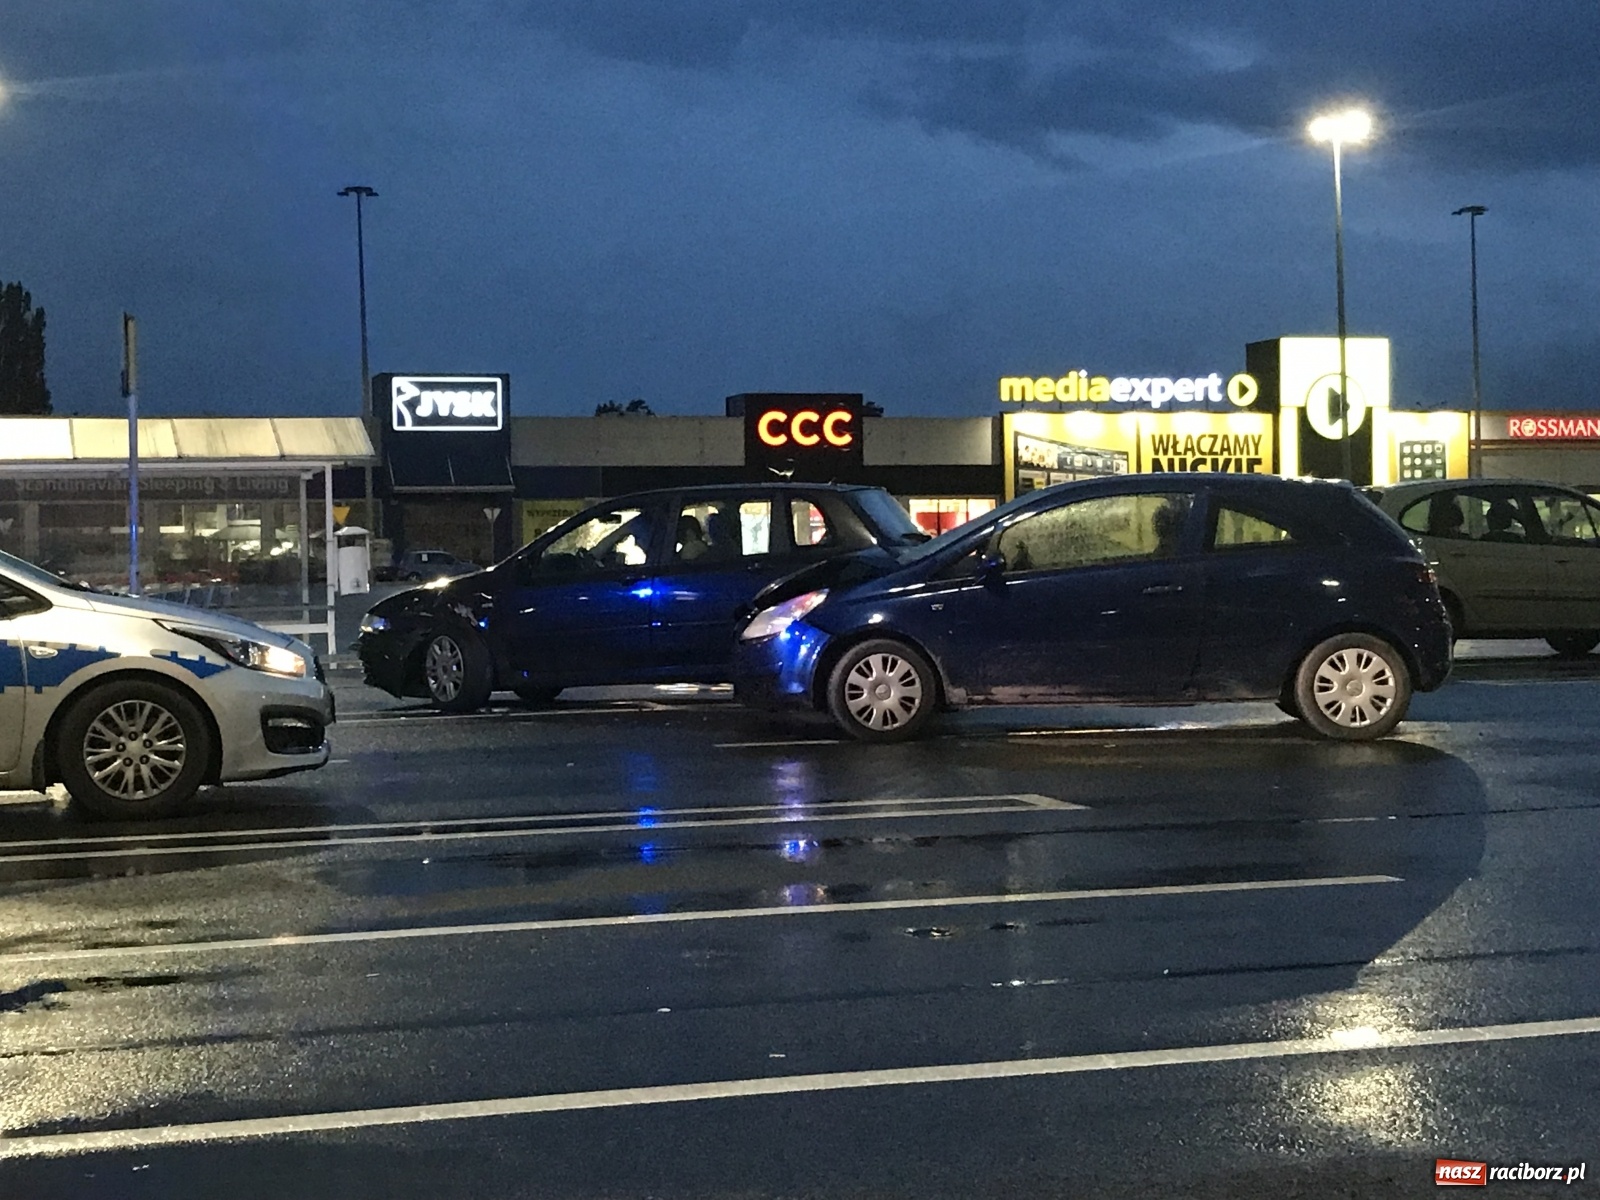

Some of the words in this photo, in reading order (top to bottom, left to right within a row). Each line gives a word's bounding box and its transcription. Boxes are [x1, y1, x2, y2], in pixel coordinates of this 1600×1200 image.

[1000, 369, 1222, 408] mediaexpert
[416, 391, 496, 417] JYSK
[757, 410, 852, 446] CCC
[1151, 434, 1262, 458] WŁĄCZAMY
[140, 476, 215, 494] Sleeping
[236, 476, 289, 493] Living
